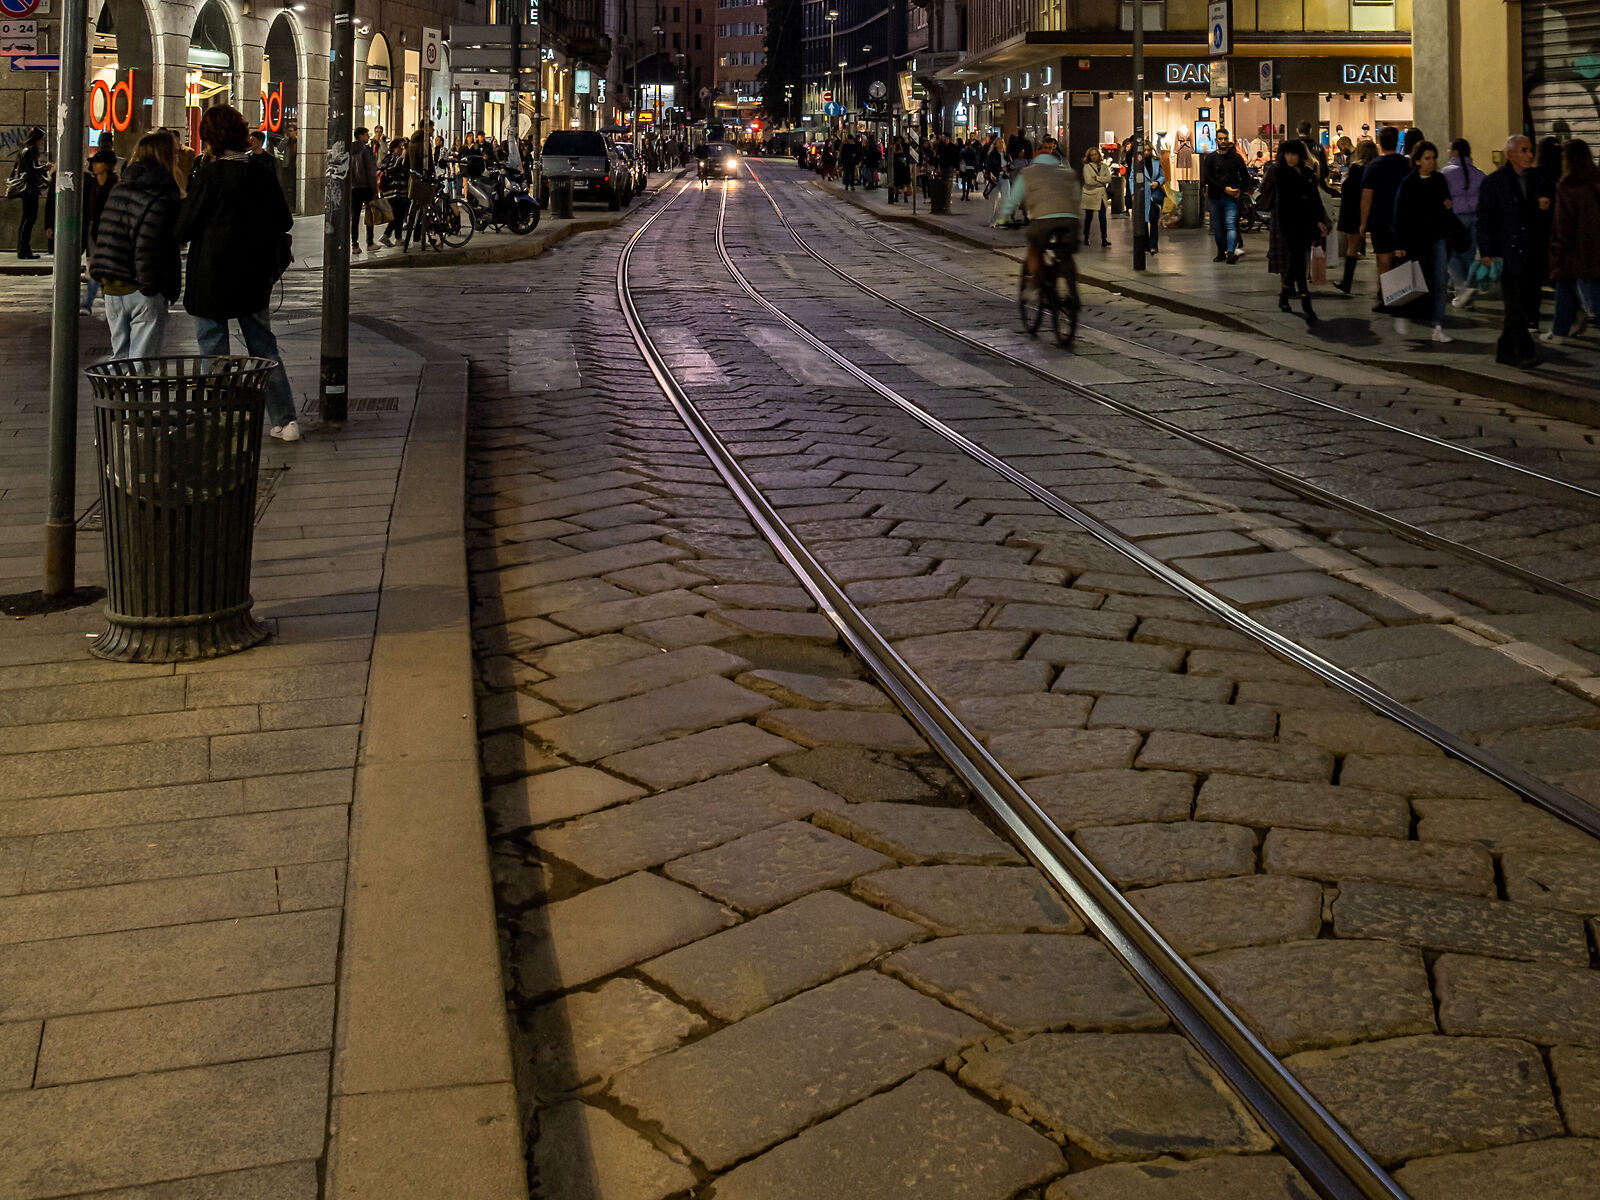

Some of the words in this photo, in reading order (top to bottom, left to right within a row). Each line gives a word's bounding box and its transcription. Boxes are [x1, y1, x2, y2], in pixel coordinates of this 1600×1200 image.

[20, 25, 34, 33] 24
[1166, 63, 1210, 83] DAN
[1343, 64, 1397, 84] DANI
